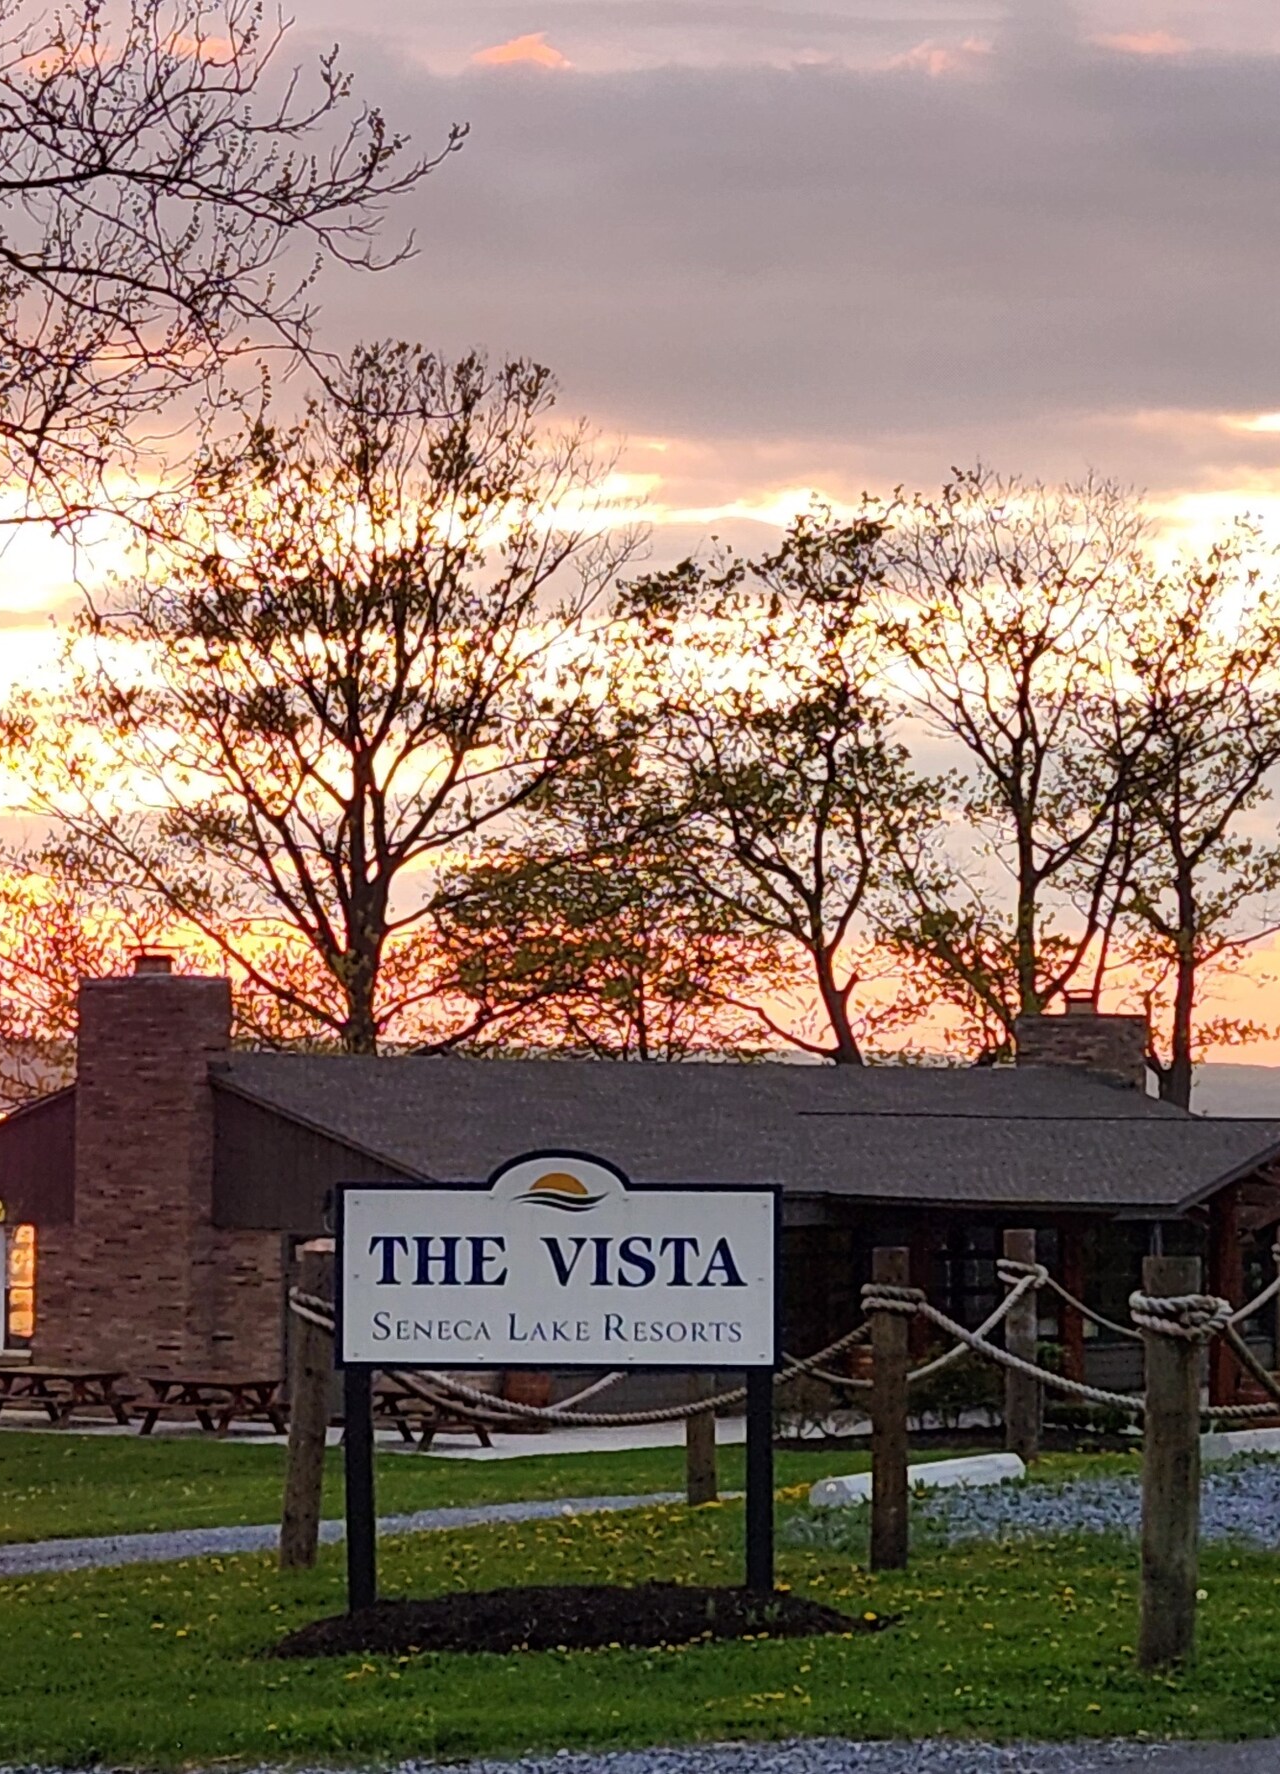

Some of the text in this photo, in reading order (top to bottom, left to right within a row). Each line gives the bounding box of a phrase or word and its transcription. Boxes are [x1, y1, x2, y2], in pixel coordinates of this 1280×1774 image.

[368, 1235, 749, 1288] THE VISTA
[371, 1310, 743, 1344] SENECA LAKE RESORTS
